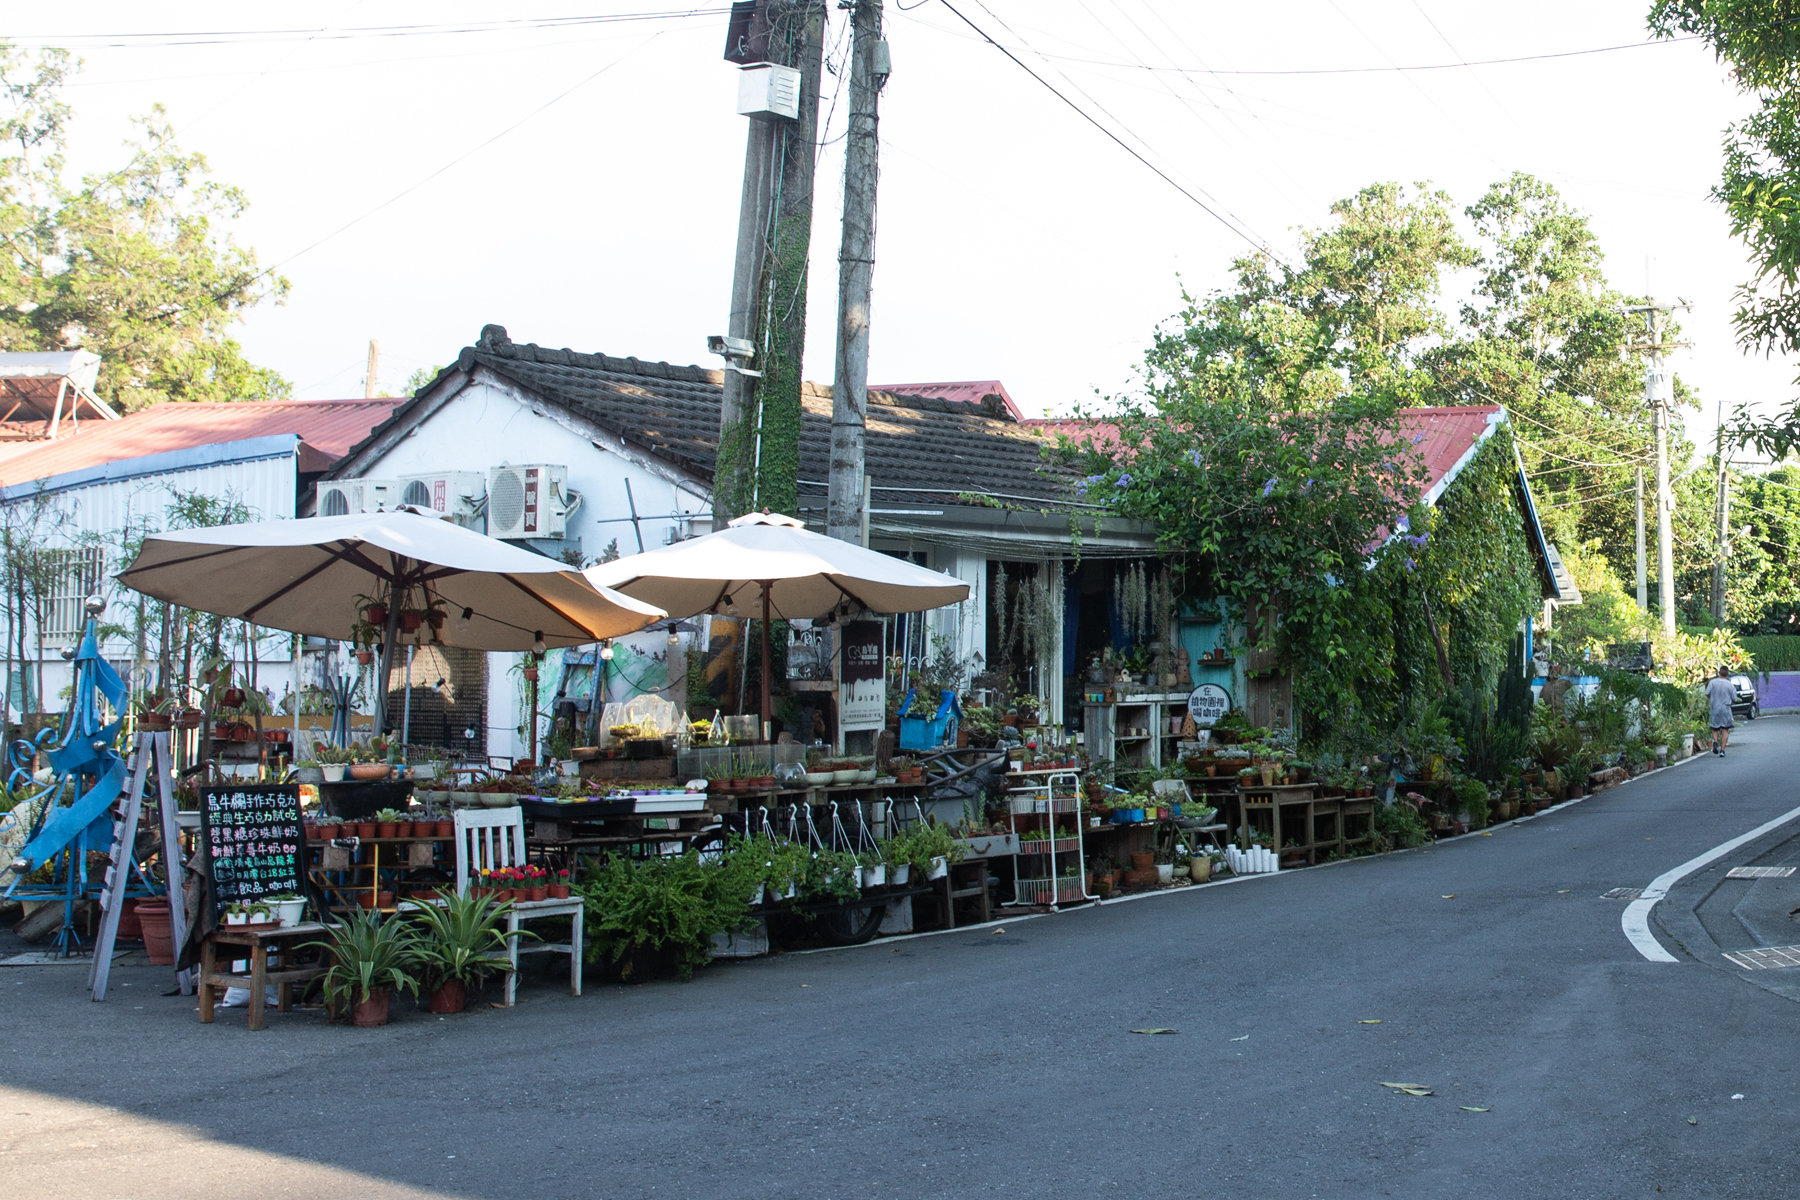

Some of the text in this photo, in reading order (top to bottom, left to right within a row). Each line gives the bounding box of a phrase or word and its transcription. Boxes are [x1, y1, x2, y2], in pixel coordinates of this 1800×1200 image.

[1203, 687, 1211, 696] 在
[209, 808, 297, 825] 經典生巧克力試吃
